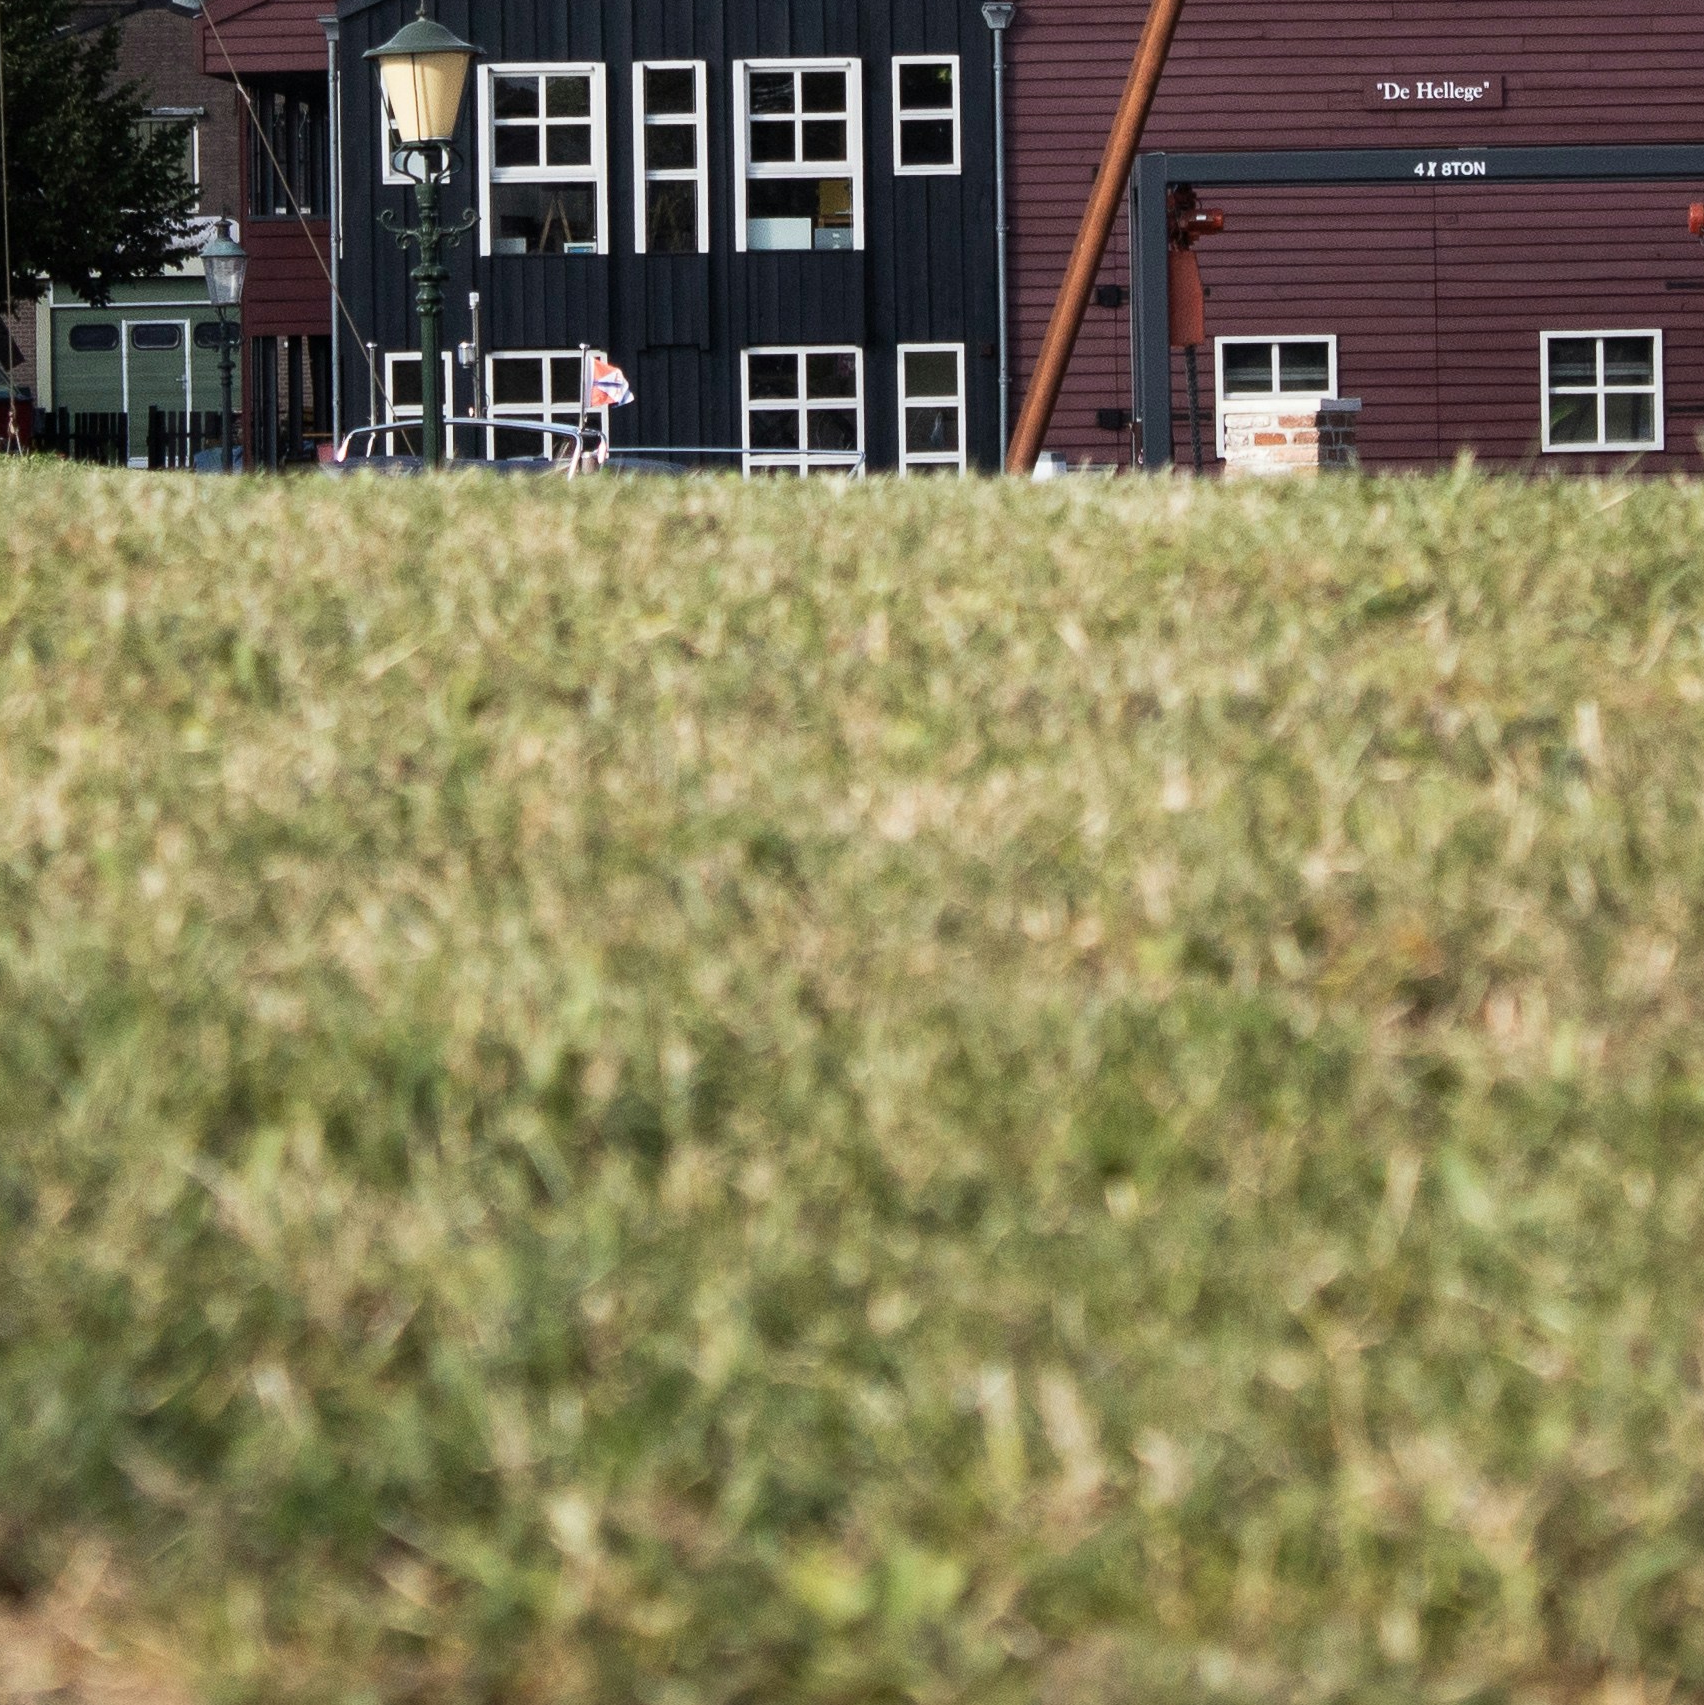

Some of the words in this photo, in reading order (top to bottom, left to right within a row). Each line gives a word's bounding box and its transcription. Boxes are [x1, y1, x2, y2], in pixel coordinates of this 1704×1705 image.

[1377, 82, 1410, 100] "De
[1416, 81, 1490, 102] Hellege"
[1414, 162, 1424, 176] 4
[1441, 162, 1486, 176] 8TON
